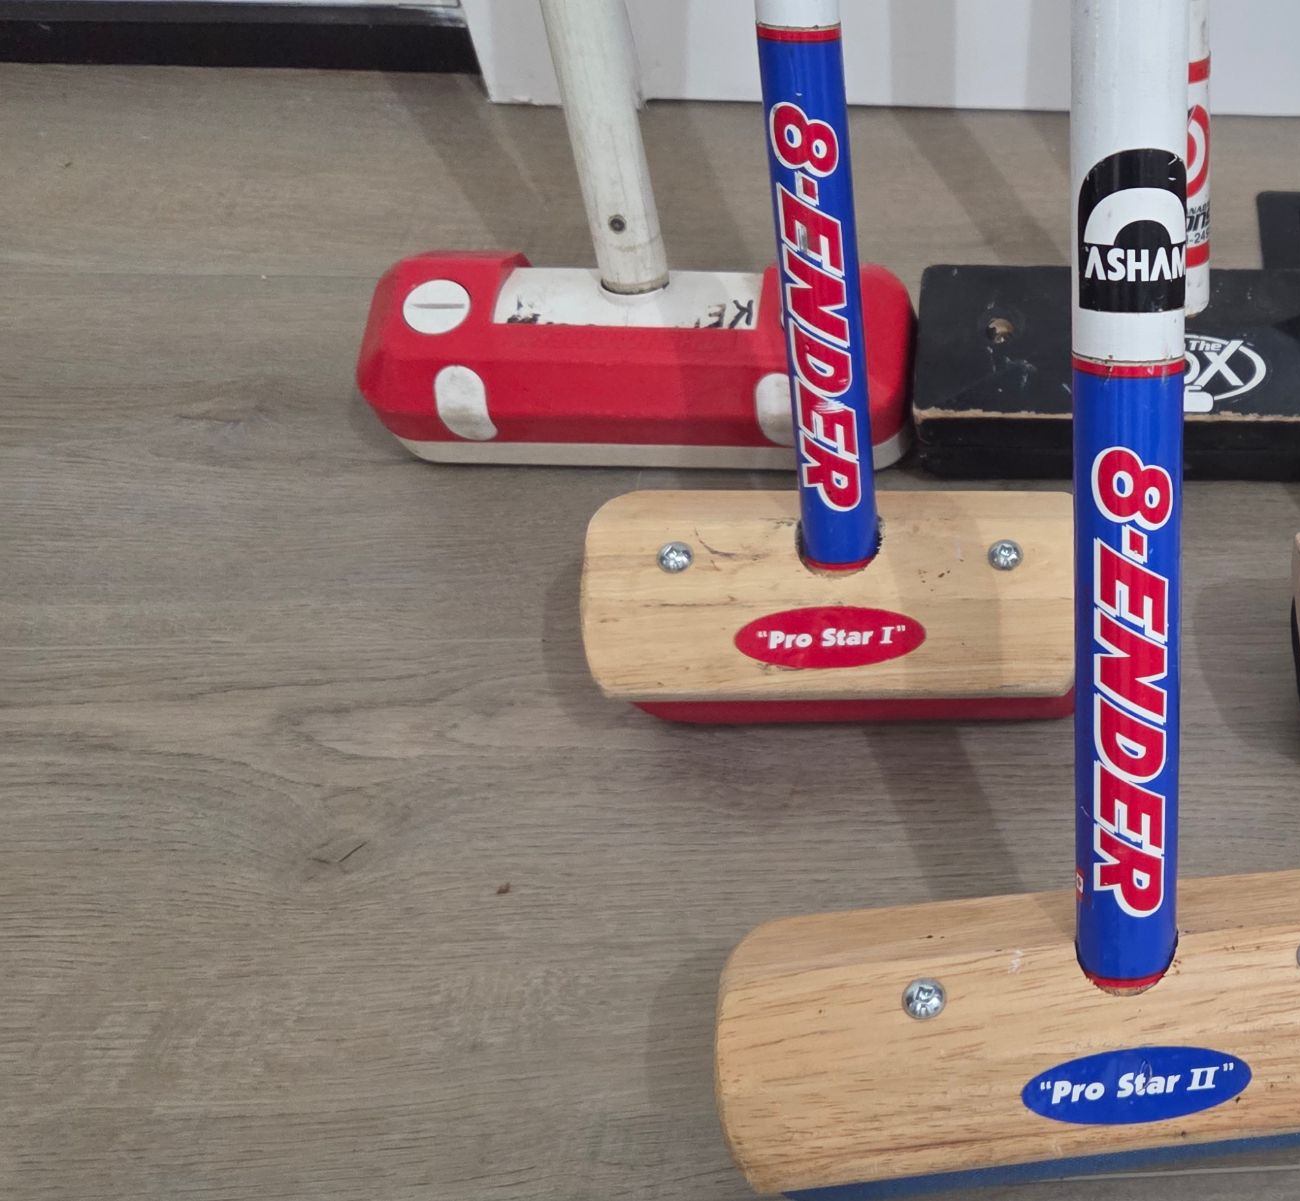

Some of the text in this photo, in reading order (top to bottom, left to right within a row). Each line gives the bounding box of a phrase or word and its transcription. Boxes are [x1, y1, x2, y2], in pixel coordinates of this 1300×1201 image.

[1084, 246, 1186, 282] ASHAM
[769, 102, 862, 512] 8-ENDER
[1189, 340, 1222, 351] The
[821, 627, 873, 647] Star
[1091, 446, 1173, 918] 8-ENDER
[1116, 1072, 1180, 1099] Star
